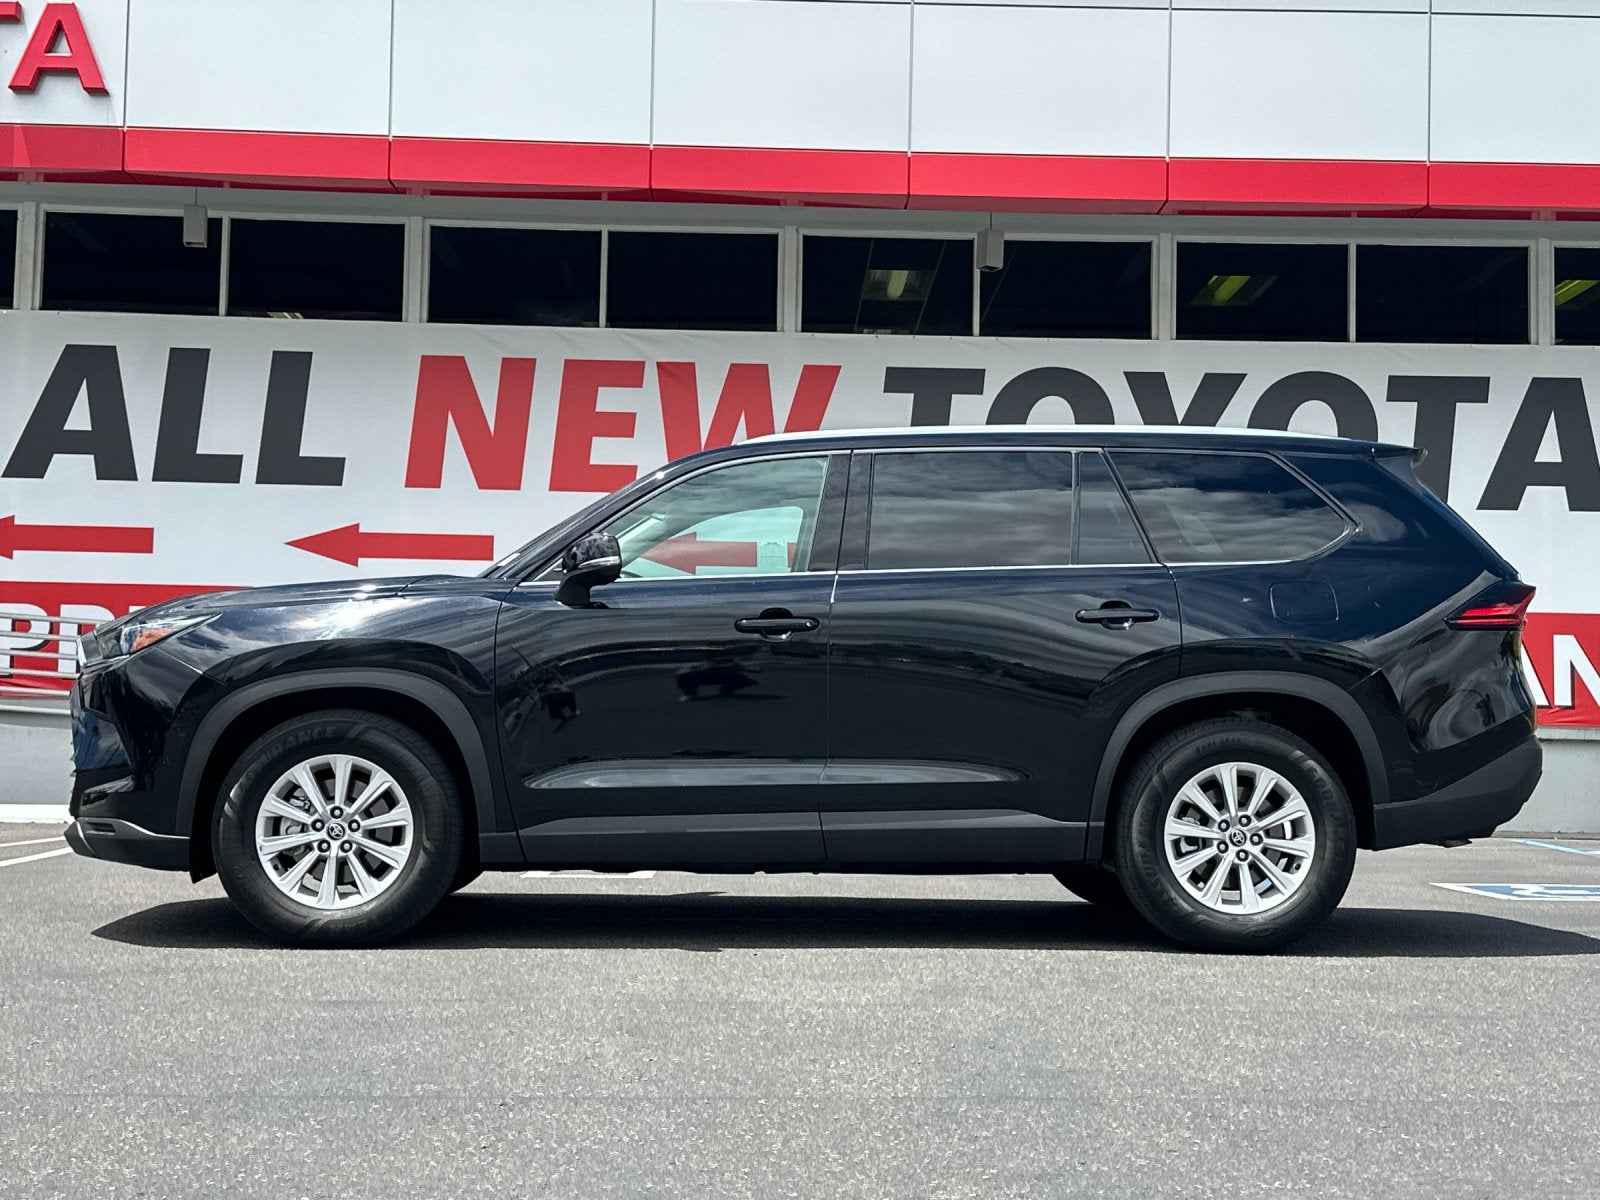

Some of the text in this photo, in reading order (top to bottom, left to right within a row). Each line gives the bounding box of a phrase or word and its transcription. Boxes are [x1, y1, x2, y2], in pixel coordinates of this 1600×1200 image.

[0, 0, 110, 96] A
[2, 343, 346, 486] ALL
[404, 354, 842, 493] NEW
